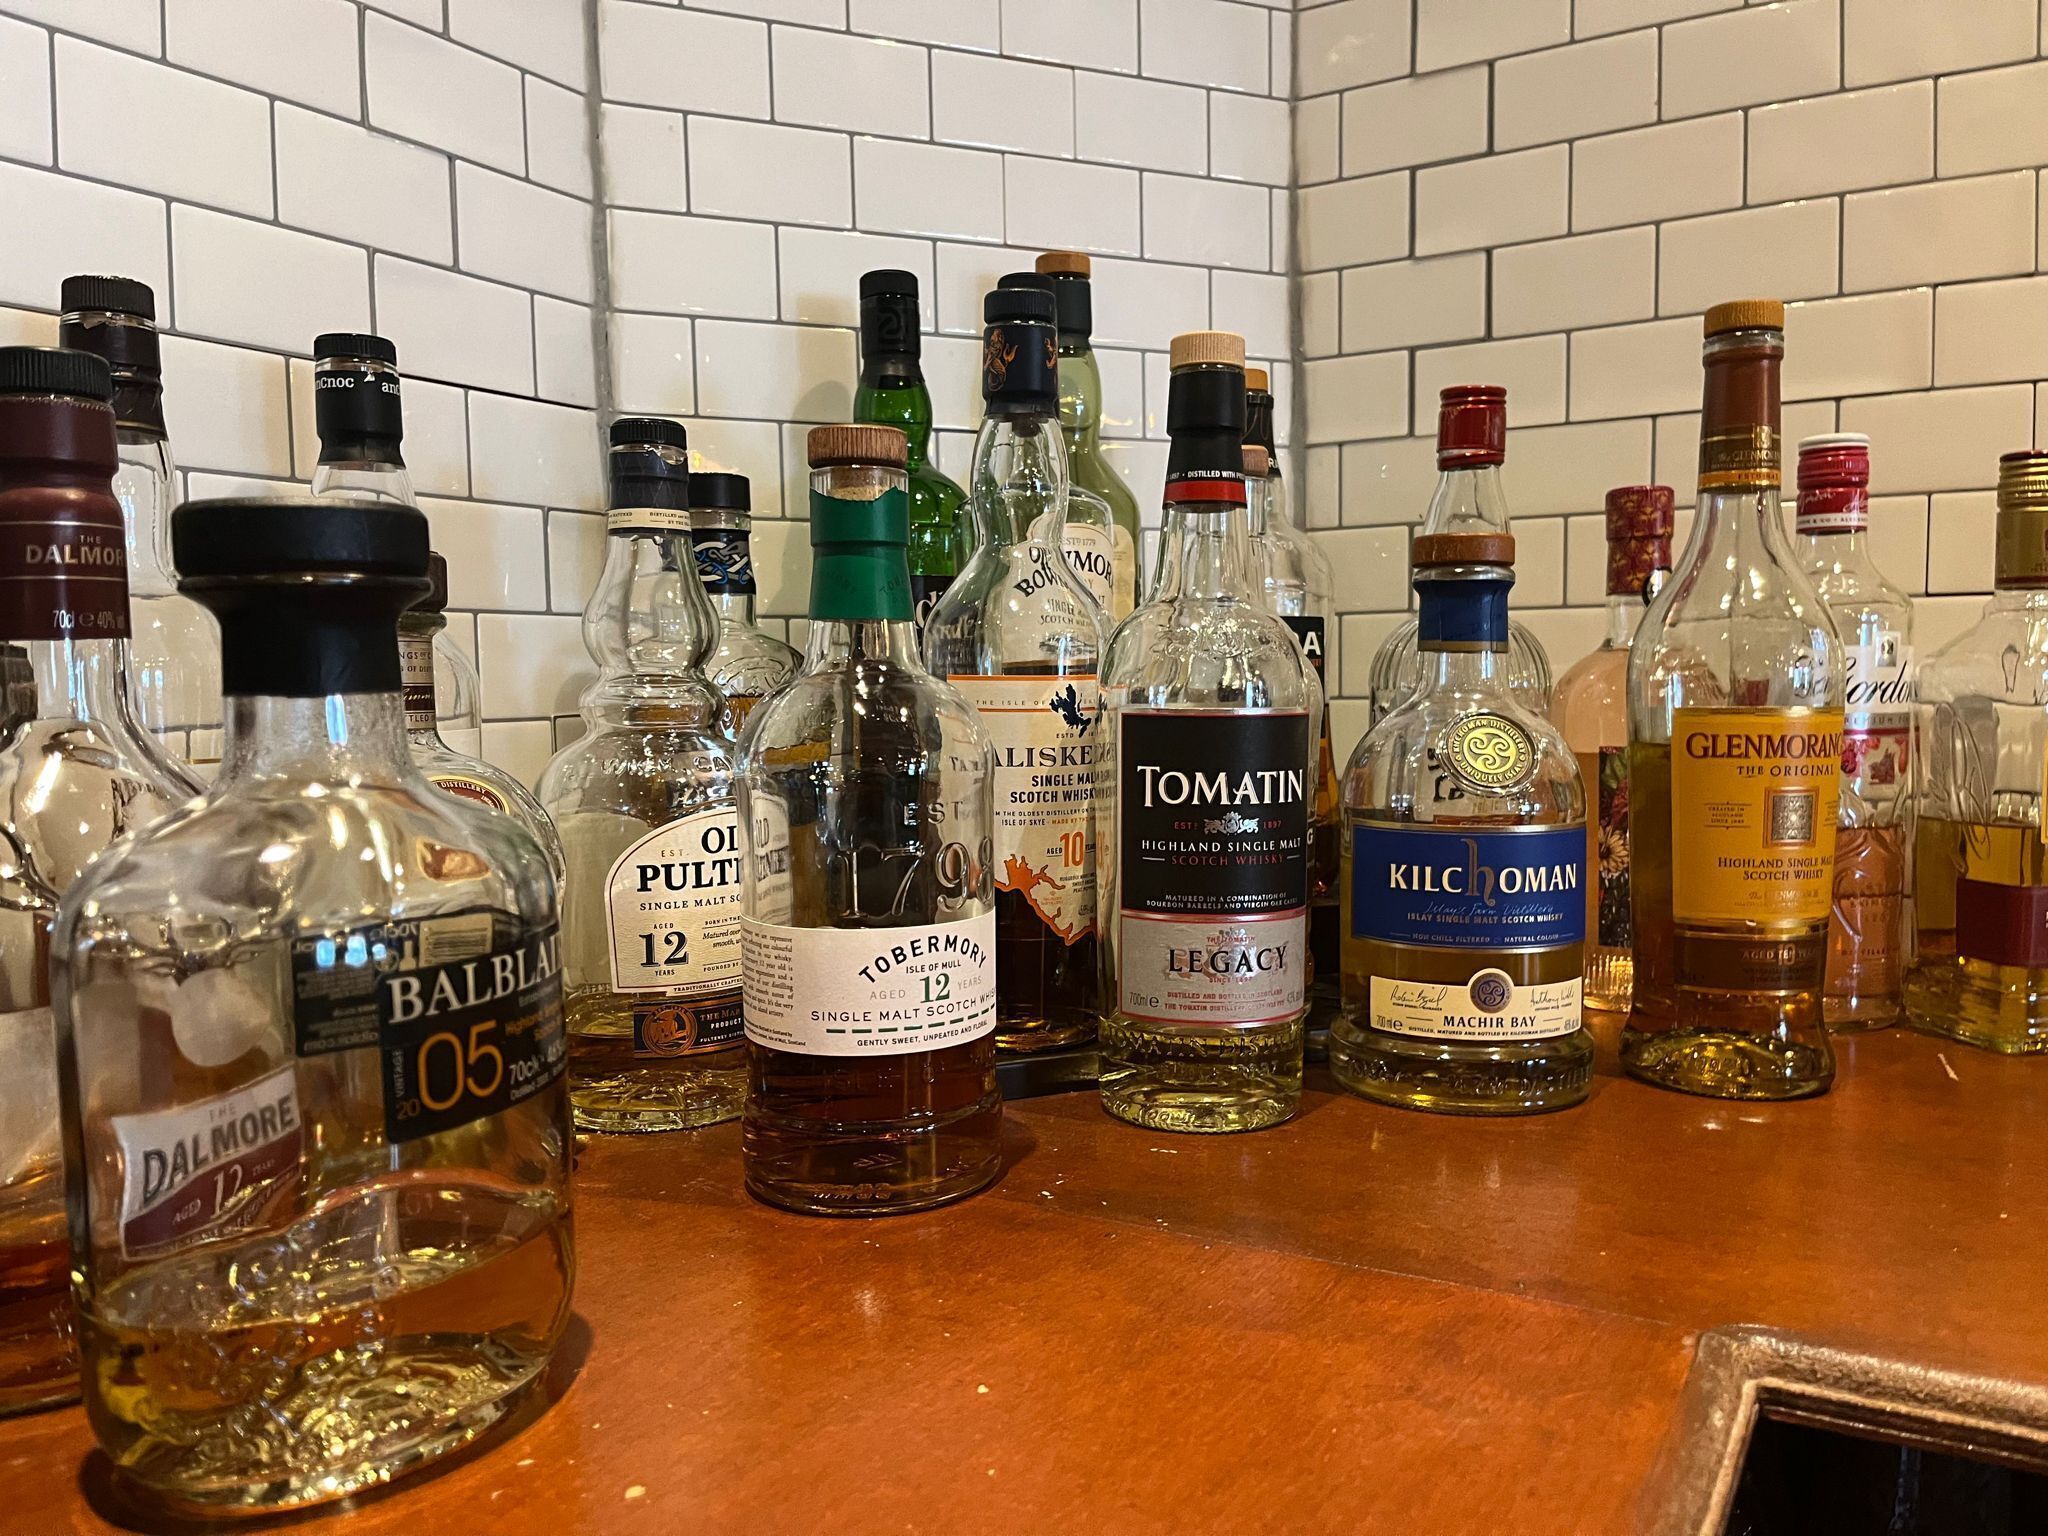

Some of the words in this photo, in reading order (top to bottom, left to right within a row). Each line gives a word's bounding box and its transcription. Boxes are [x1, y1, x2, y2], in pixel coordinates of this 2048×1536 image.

[1187, 470, 1220, 478] DISTILLED
[1222, 470, 1236, 479] WITH
[80, 535, 101, 544] THE
[52, 610, 75, 628] 70cl
[1737, 765, 1764, 776] THE
[1769, 764, 1834, 777] ORIGINAL
[1031, 773, 1074, 787] SINGLE
[1137, 765, 1304, 807] TOMATIN
[440, 781, 486, 794] DISTILLERY
[1010, 790, 1058, 803] SCOTCH
[1046, 808, 1080, 816] DISTILLERY
[1029, 818, 1046, 826] SKYE
[1046, 847, 1062, 855] AGED
[1060, 831, 1084, 868] 10
[1142, 839, 1221, 852] HIGHLAND
[1228, 840, 1276, 852] SINGLE
[1279, 837, 1301, 849] MALT
[1171, 855, 1228, 866] SCOTCH
[1236, 853, 1284, 865] WHISKY
[1718, 856, 1783, 868] HIGHLAND
[1786, 856, 1819, 868] SINGLE
[1743, 870, 1789, 881] SCOTCH
[1793, 868, 1824, 880] WHISKY
[640, 900, 689, 911] SINGLE
[694, 896, 726, 908] MALT
[1146, 899, 1184, 909] BOURBON
[1243, 900, 1269, 909] VIRGIN
[1165, 894, 1204, 902] MATURED
[1226, 893, 1278, 902] COMBINATION
[1407, 912, 1432, 921] ISLAY
[1436, 914, 1470, 924] SINGLE
[1473, 916, 1498, 924] MALT
[1502, 915, 1534, 924] SCOTCH
[1537, 912, 1563, 922] WHISKY
[653, 922, 675, 930] AGED
[702, 930, 729, 940] Matured
[1431, 934, 1454, 942] CHILL
[1504, 934, 1535, 943] NATURAL
[638, 931, 689, 968] 12
[1742, 951, 1774, 960] AGED
[858, 934, 987, 983] TOBERMORY
[1168, 945, 1287, 974] LEGACY
[655, 968, 675, 977] YEARS
[703, 962, 731, 972] FOUNDED
[905, 964, 926, 974] ISLE
[928, 963, 939, 971] OF
[941, 959, 962, 970] MULL
[673, 982, 720, 992] TRADITIONALLY
[721, 977, 742, 985] CRAFTED
[869, 989, 906, 1001] AGED
[919, 972, 951, 1004] 12
[957, 975, 983, 991] YEARS
[1167, 991, 1200, 1000] DISTILLED
[811, 1009, 872, 1022] SINGLE
[879, 1008, 921, 1021] MALT
[926, 996, 977, 1017] SCOTCH
[1179, 1003, 1207, 1011] TOMATIN
[710, 1017, 742, 1030] PRODUCT
[1443, 1015, 1504, 1028] MACHIR
[1511, 1015, 1536, 1028] BAY
[856, 1038, 889, 1047] GENTLY
[891, 1036, 921, 1045] SWEET,
[923, 1029, 959, 1042] UNPEATED
[960, 1024, 972, 1034] AND
[1408, 1025, 1435, 1034] DISTILLED,
[417, 1019, 503, 1111] 05
[142, 1094, 296, 1209] DALMORE
[210, 1163, 243, 1219] 12
